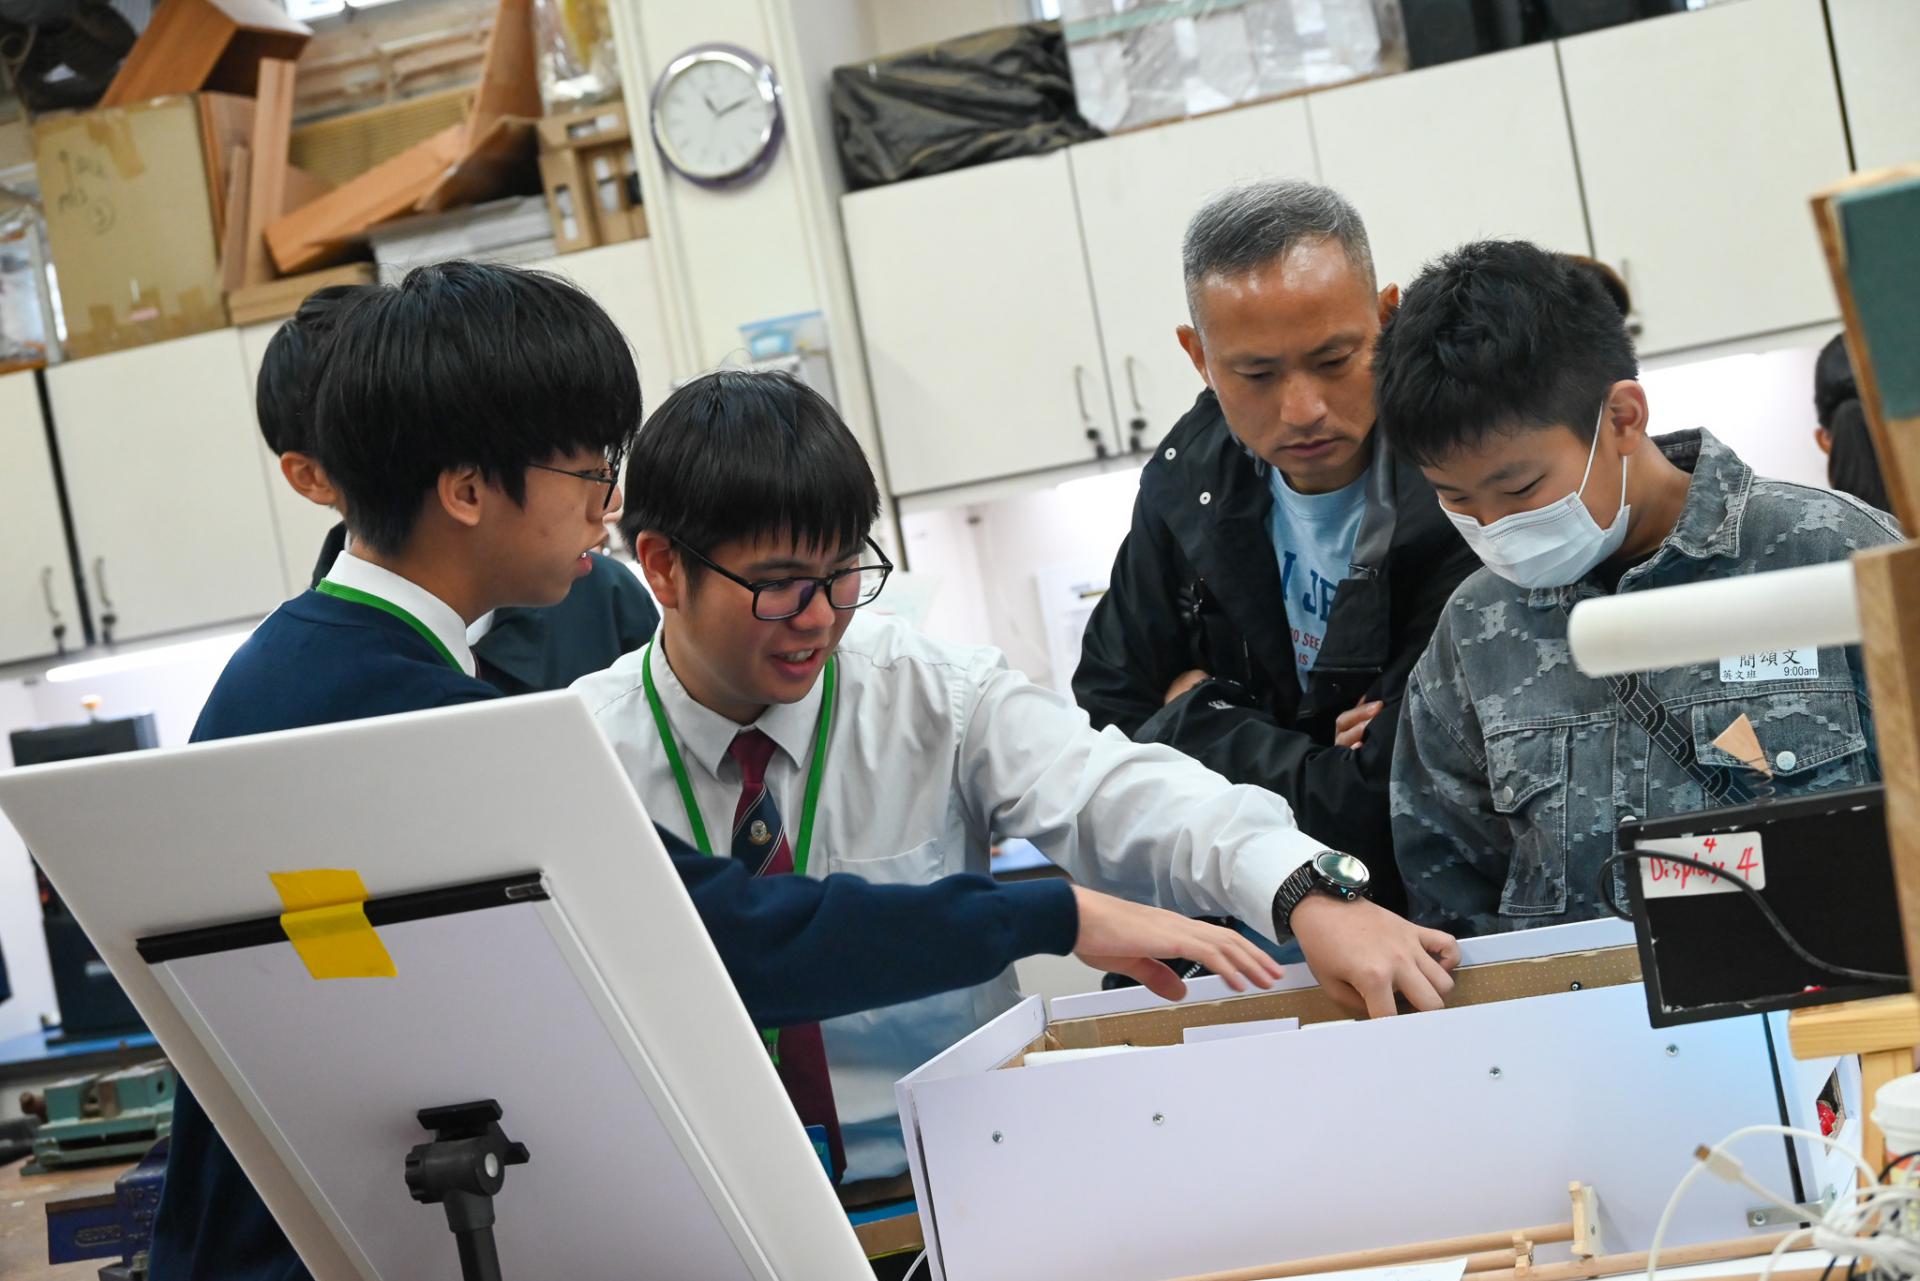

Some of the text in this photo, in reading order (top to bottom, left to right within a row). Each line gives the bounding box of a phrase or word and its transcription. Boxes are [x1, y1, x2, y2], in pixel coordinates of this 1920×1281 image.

[1783, 666, 1818, 677] 9:00am
[1703, 837, 1717, 853] 4
[1736, 846, 1759, 881] 4
